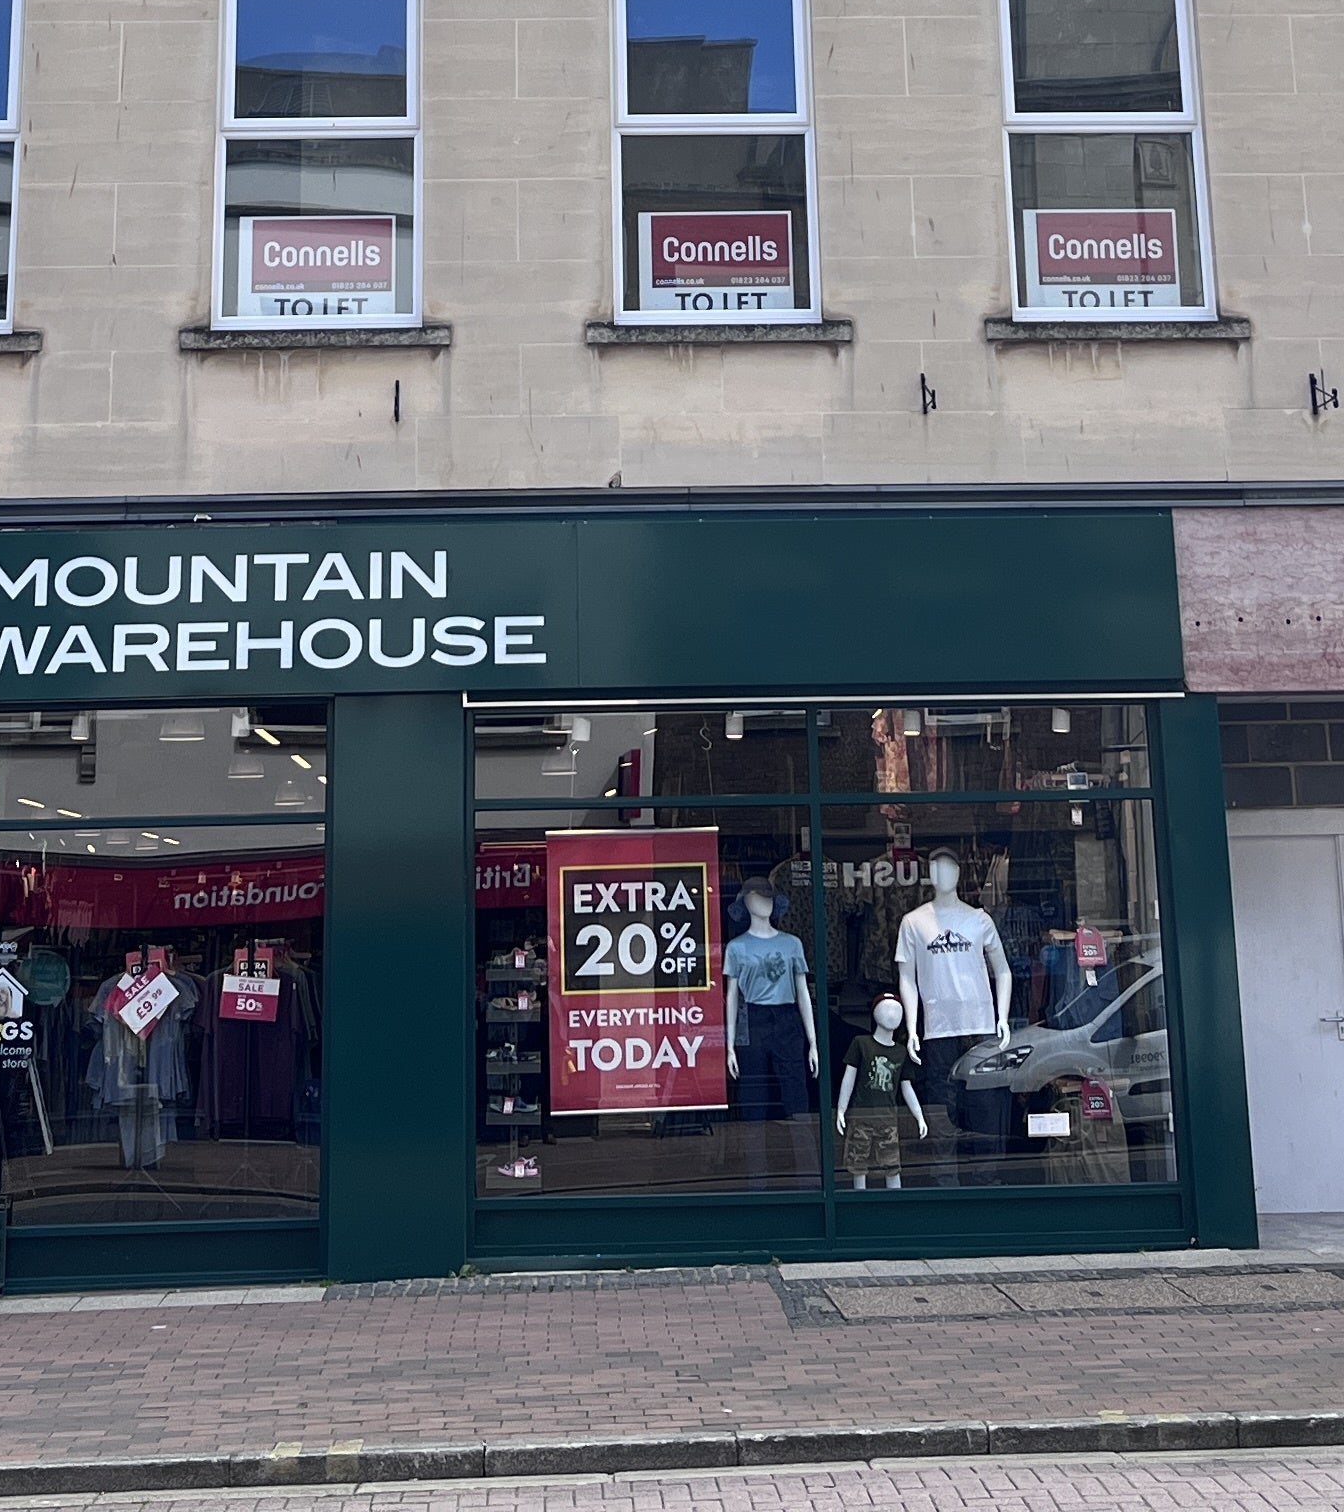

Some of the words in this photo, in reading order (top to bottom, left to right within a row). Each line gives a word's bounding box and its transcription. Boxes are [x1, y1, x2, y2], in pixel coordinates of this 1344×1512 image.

[263, 240, 381, 267] Connells
[663, 236, 778, 263] Connells
[1048, 233, 1163, 260] Connells
[572, 880, 696, 914] EXTRA
[575, 922, 697, 976] 20%
[660, 957, 697, 974] OFF
[124, 975, 150, 1000] SALE
[238, 983, 264, 992] SALE
[568, 1006, 704, 1028] EVERYTHING
[2, 1058, 28, 1068] store
[569, 1035, 705, 1072] TODAY
